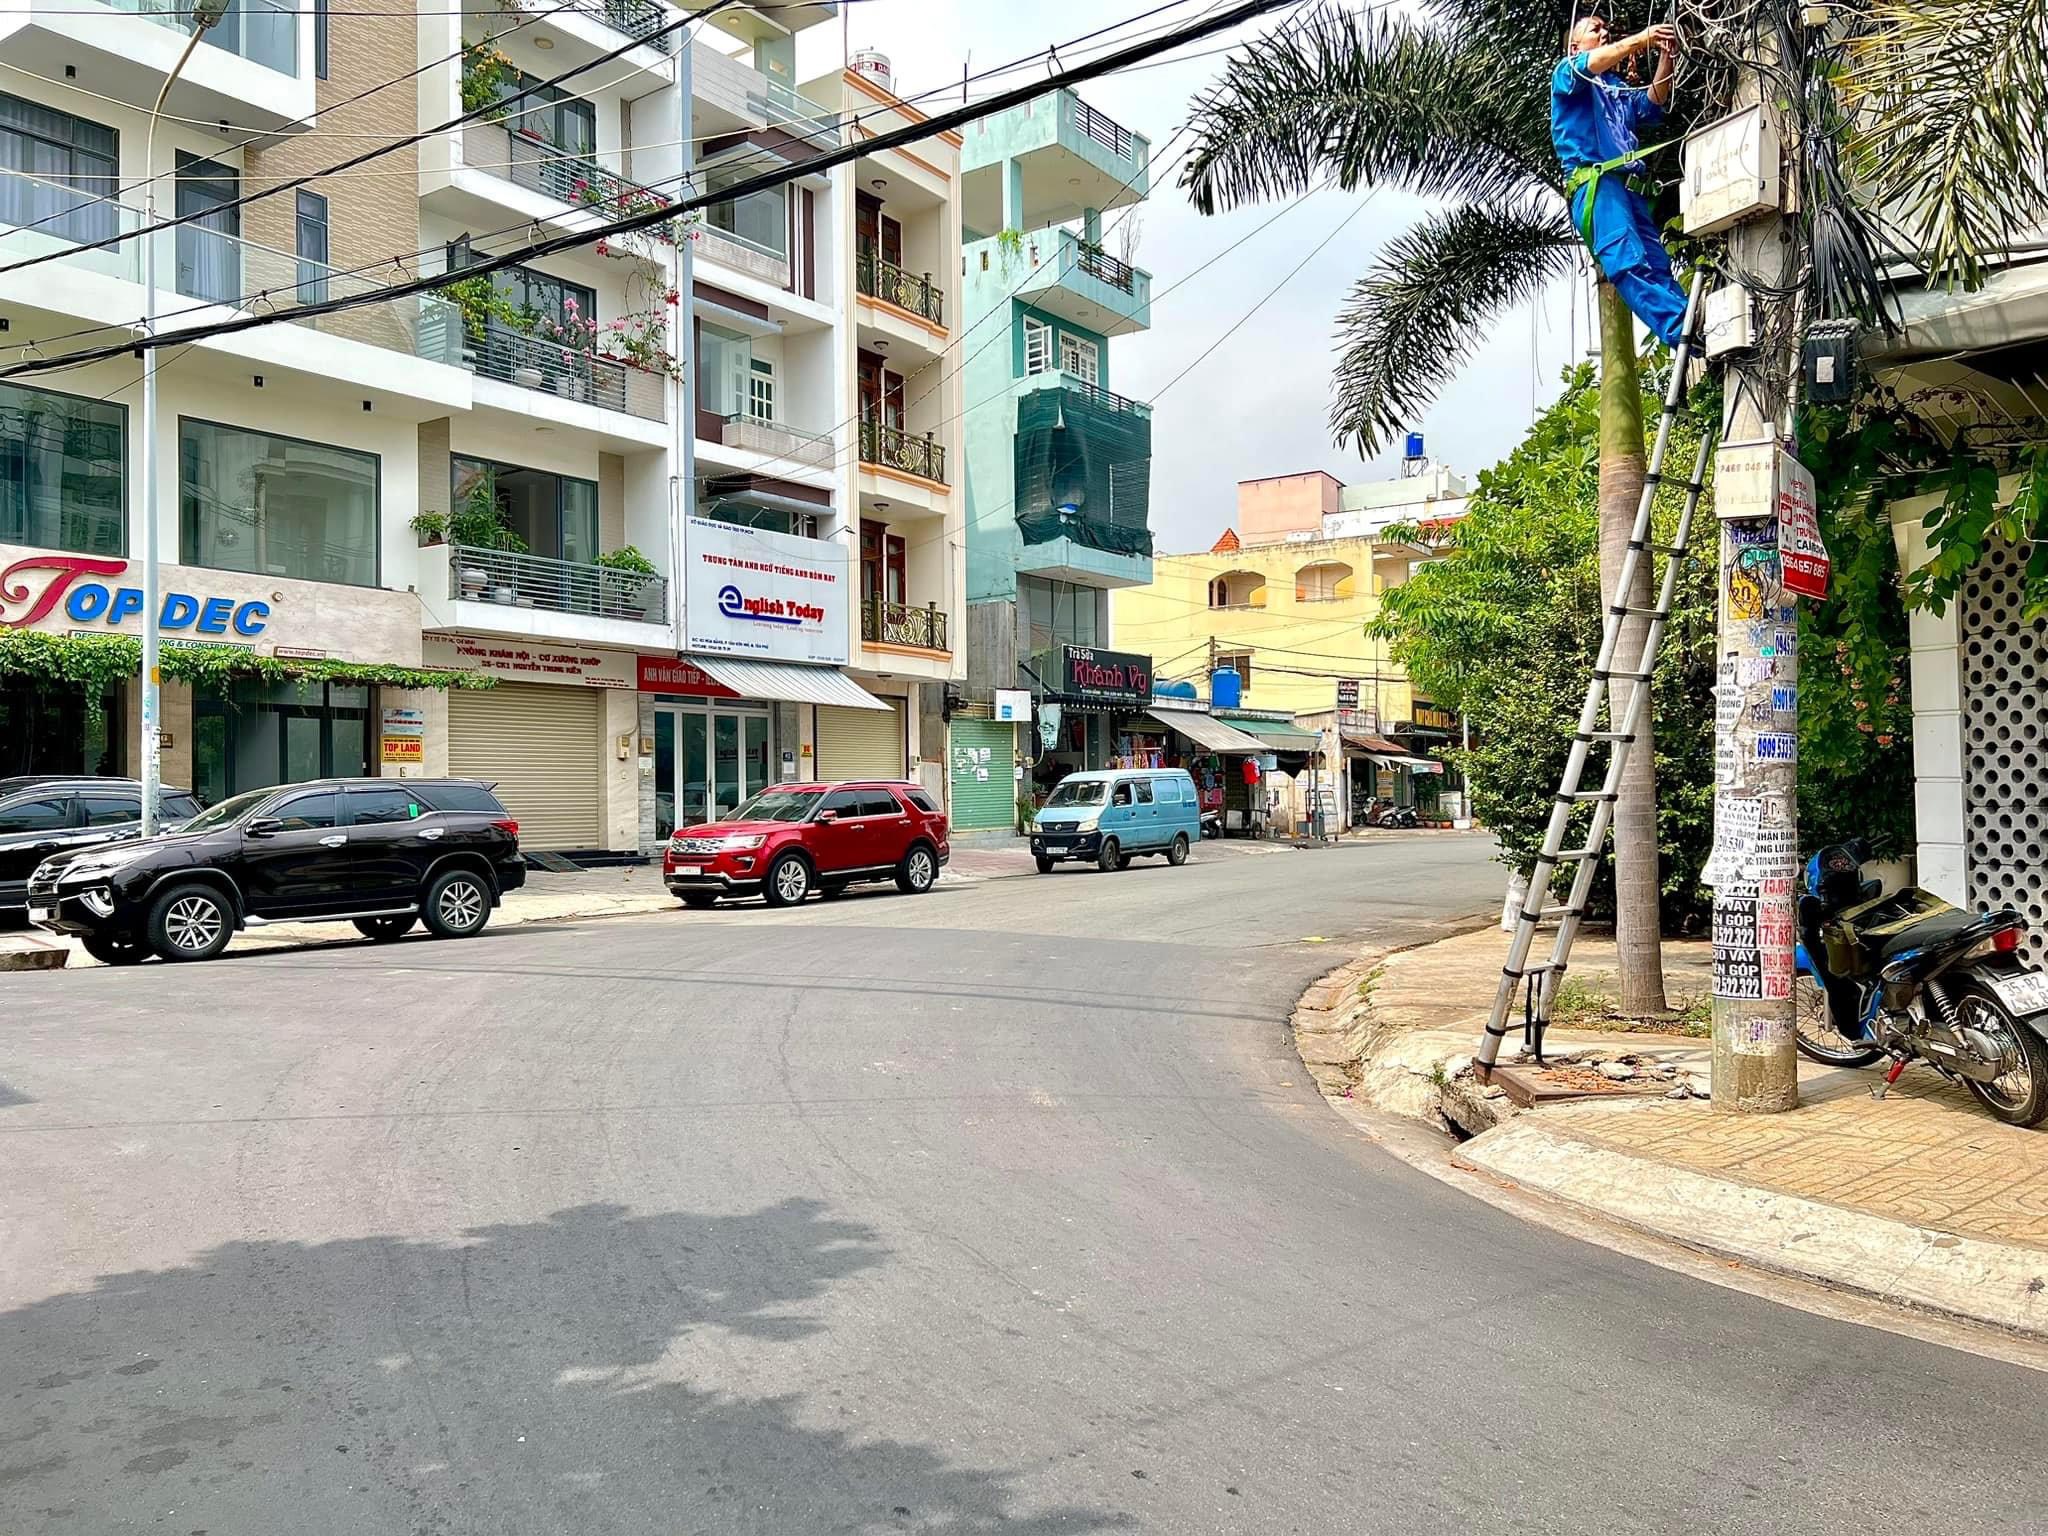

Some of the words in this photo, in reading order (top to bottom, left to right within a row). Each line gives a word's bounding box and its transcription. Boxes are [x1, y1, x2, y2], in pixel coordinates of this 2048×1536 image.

[702, 553, 727, 565] TRUNG
[786, 600, 825, 622] Today
[1072, 660, 1125, 692] Khánh
[1128, 664, 1148, 695] Vy
[384, 743, 398, 752] TOP
[401, 743, 421, 753] LAND
[1727, 900, 1751, 912] VAY
[1726, 912, 1754, 926] GÓP
[1729, 950, 1756, 962] VAY
[1729, 962, 1759, 976] GÓP
